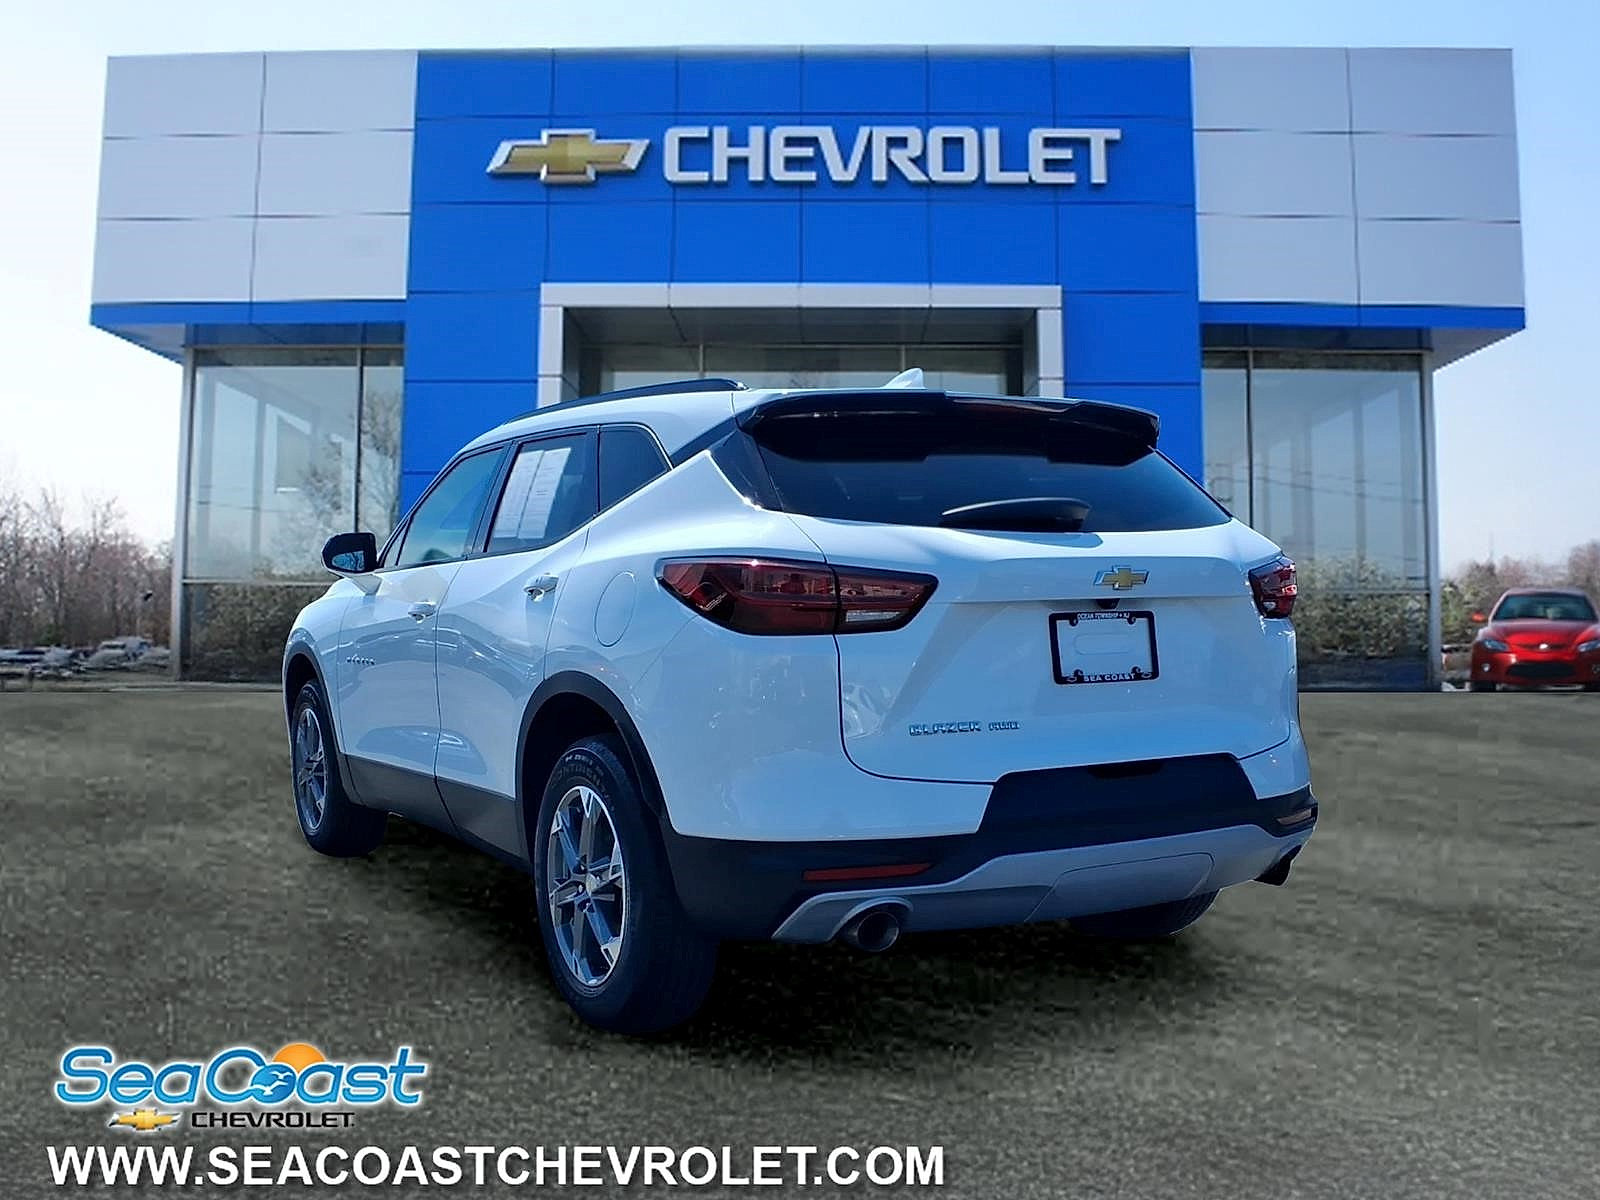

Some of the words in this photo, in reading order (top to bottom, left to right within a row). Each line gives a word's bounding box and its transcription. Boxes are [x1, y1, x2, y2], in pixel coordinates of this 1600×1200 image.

[663, 126, 1122, 186] CHEVROLET
[1104, 673, 1136, 681] COAST
[909, 721, 981, 736] BLAZER
